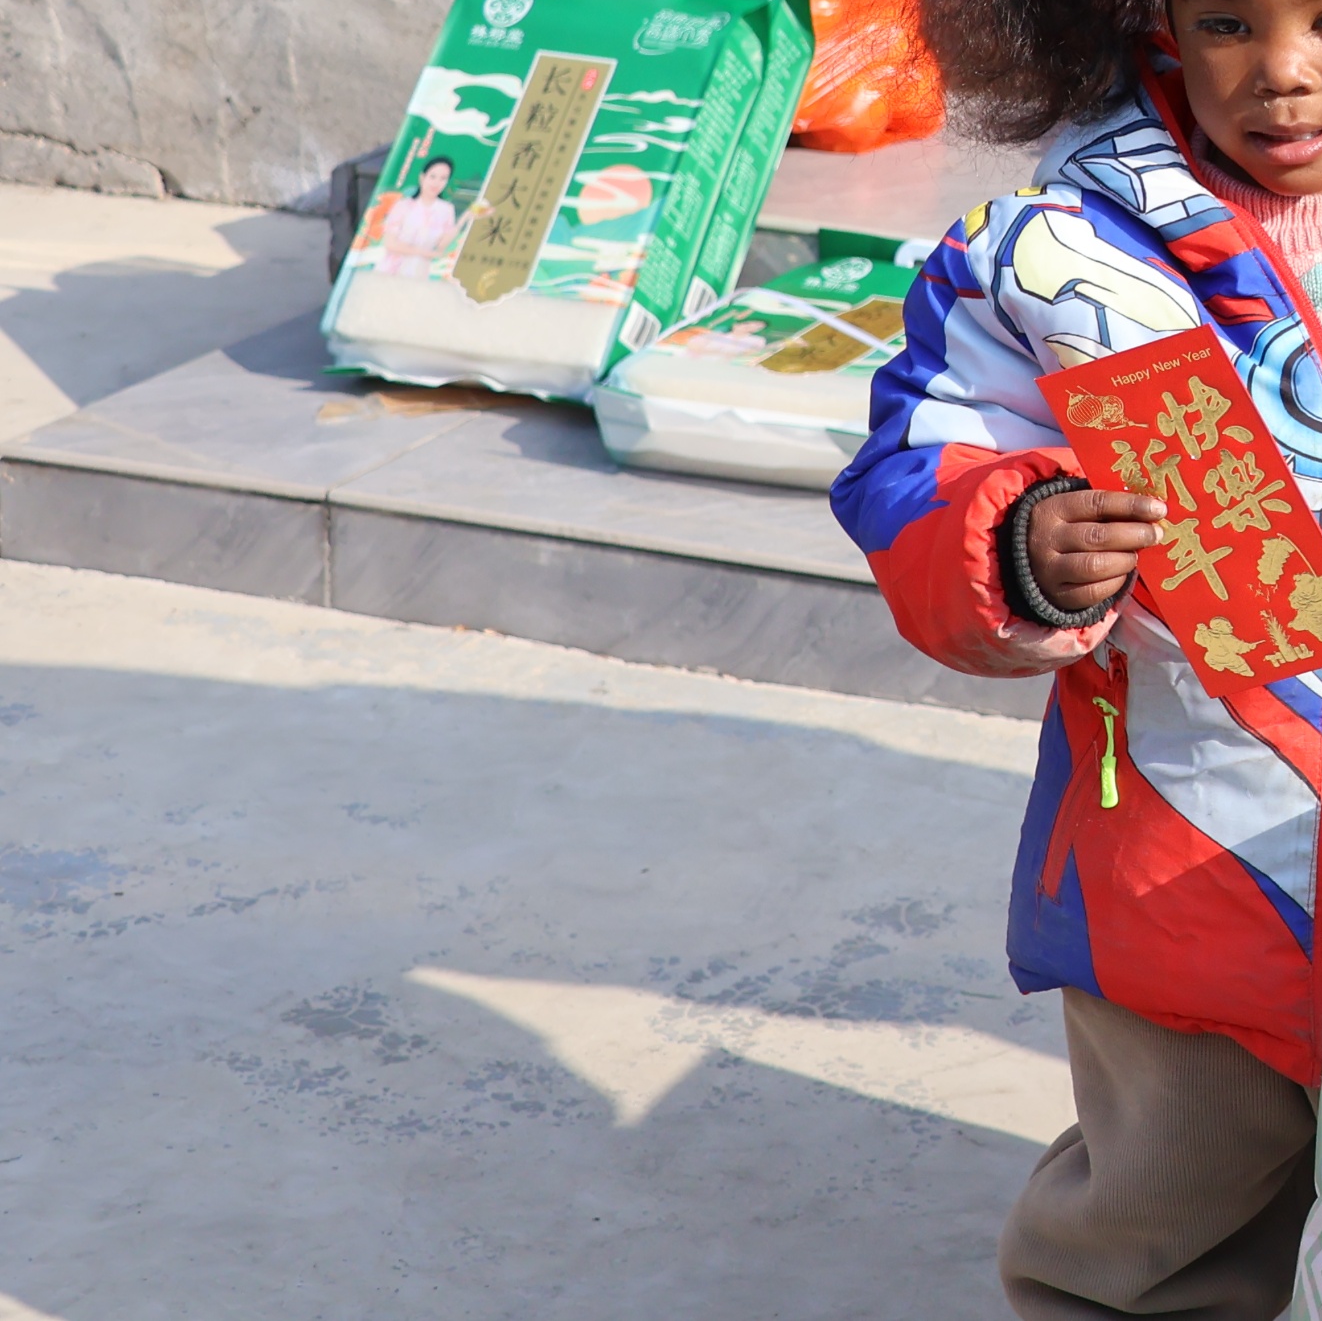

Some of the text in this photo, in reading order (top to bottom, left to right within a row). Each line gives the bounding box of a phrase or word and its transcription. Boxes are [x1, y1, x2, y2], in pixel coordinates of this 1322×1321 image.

[476, 64, 576, 249] 长粒香大米
[1110, 346, 1212, 388] Happy New Year
